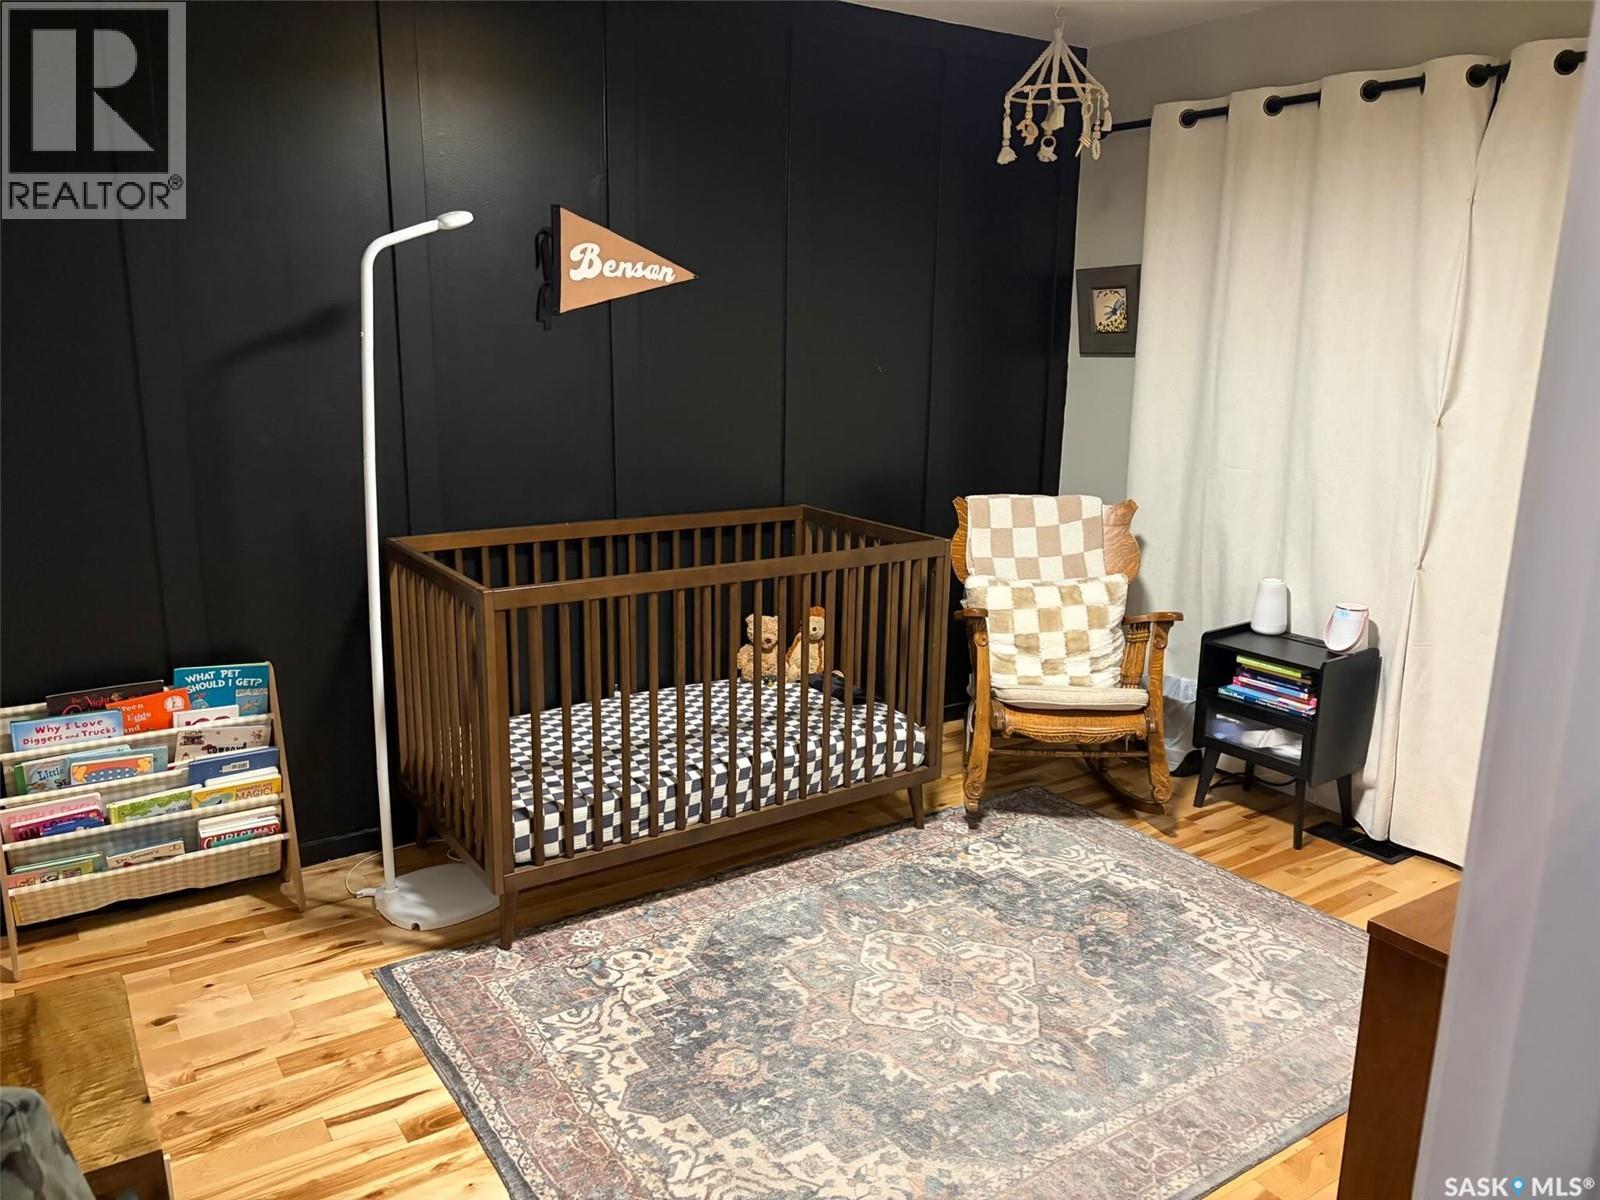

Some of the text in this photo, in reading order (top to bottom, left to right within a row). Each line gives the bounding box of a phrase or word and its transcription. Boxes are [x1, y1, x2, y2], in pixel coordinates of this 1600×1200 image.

[569, 242, 677, 283] Benson
[184, 669, 241, 684] WHAT PET
[186, 678, 263, 694] SHOULD I GET?
[34, 719, 104, 735] Why I Love
[22, 734, 63, 746] Diggers
[81, 726, 118, 738] Trucks
[36, 768, 65, 781] Little
